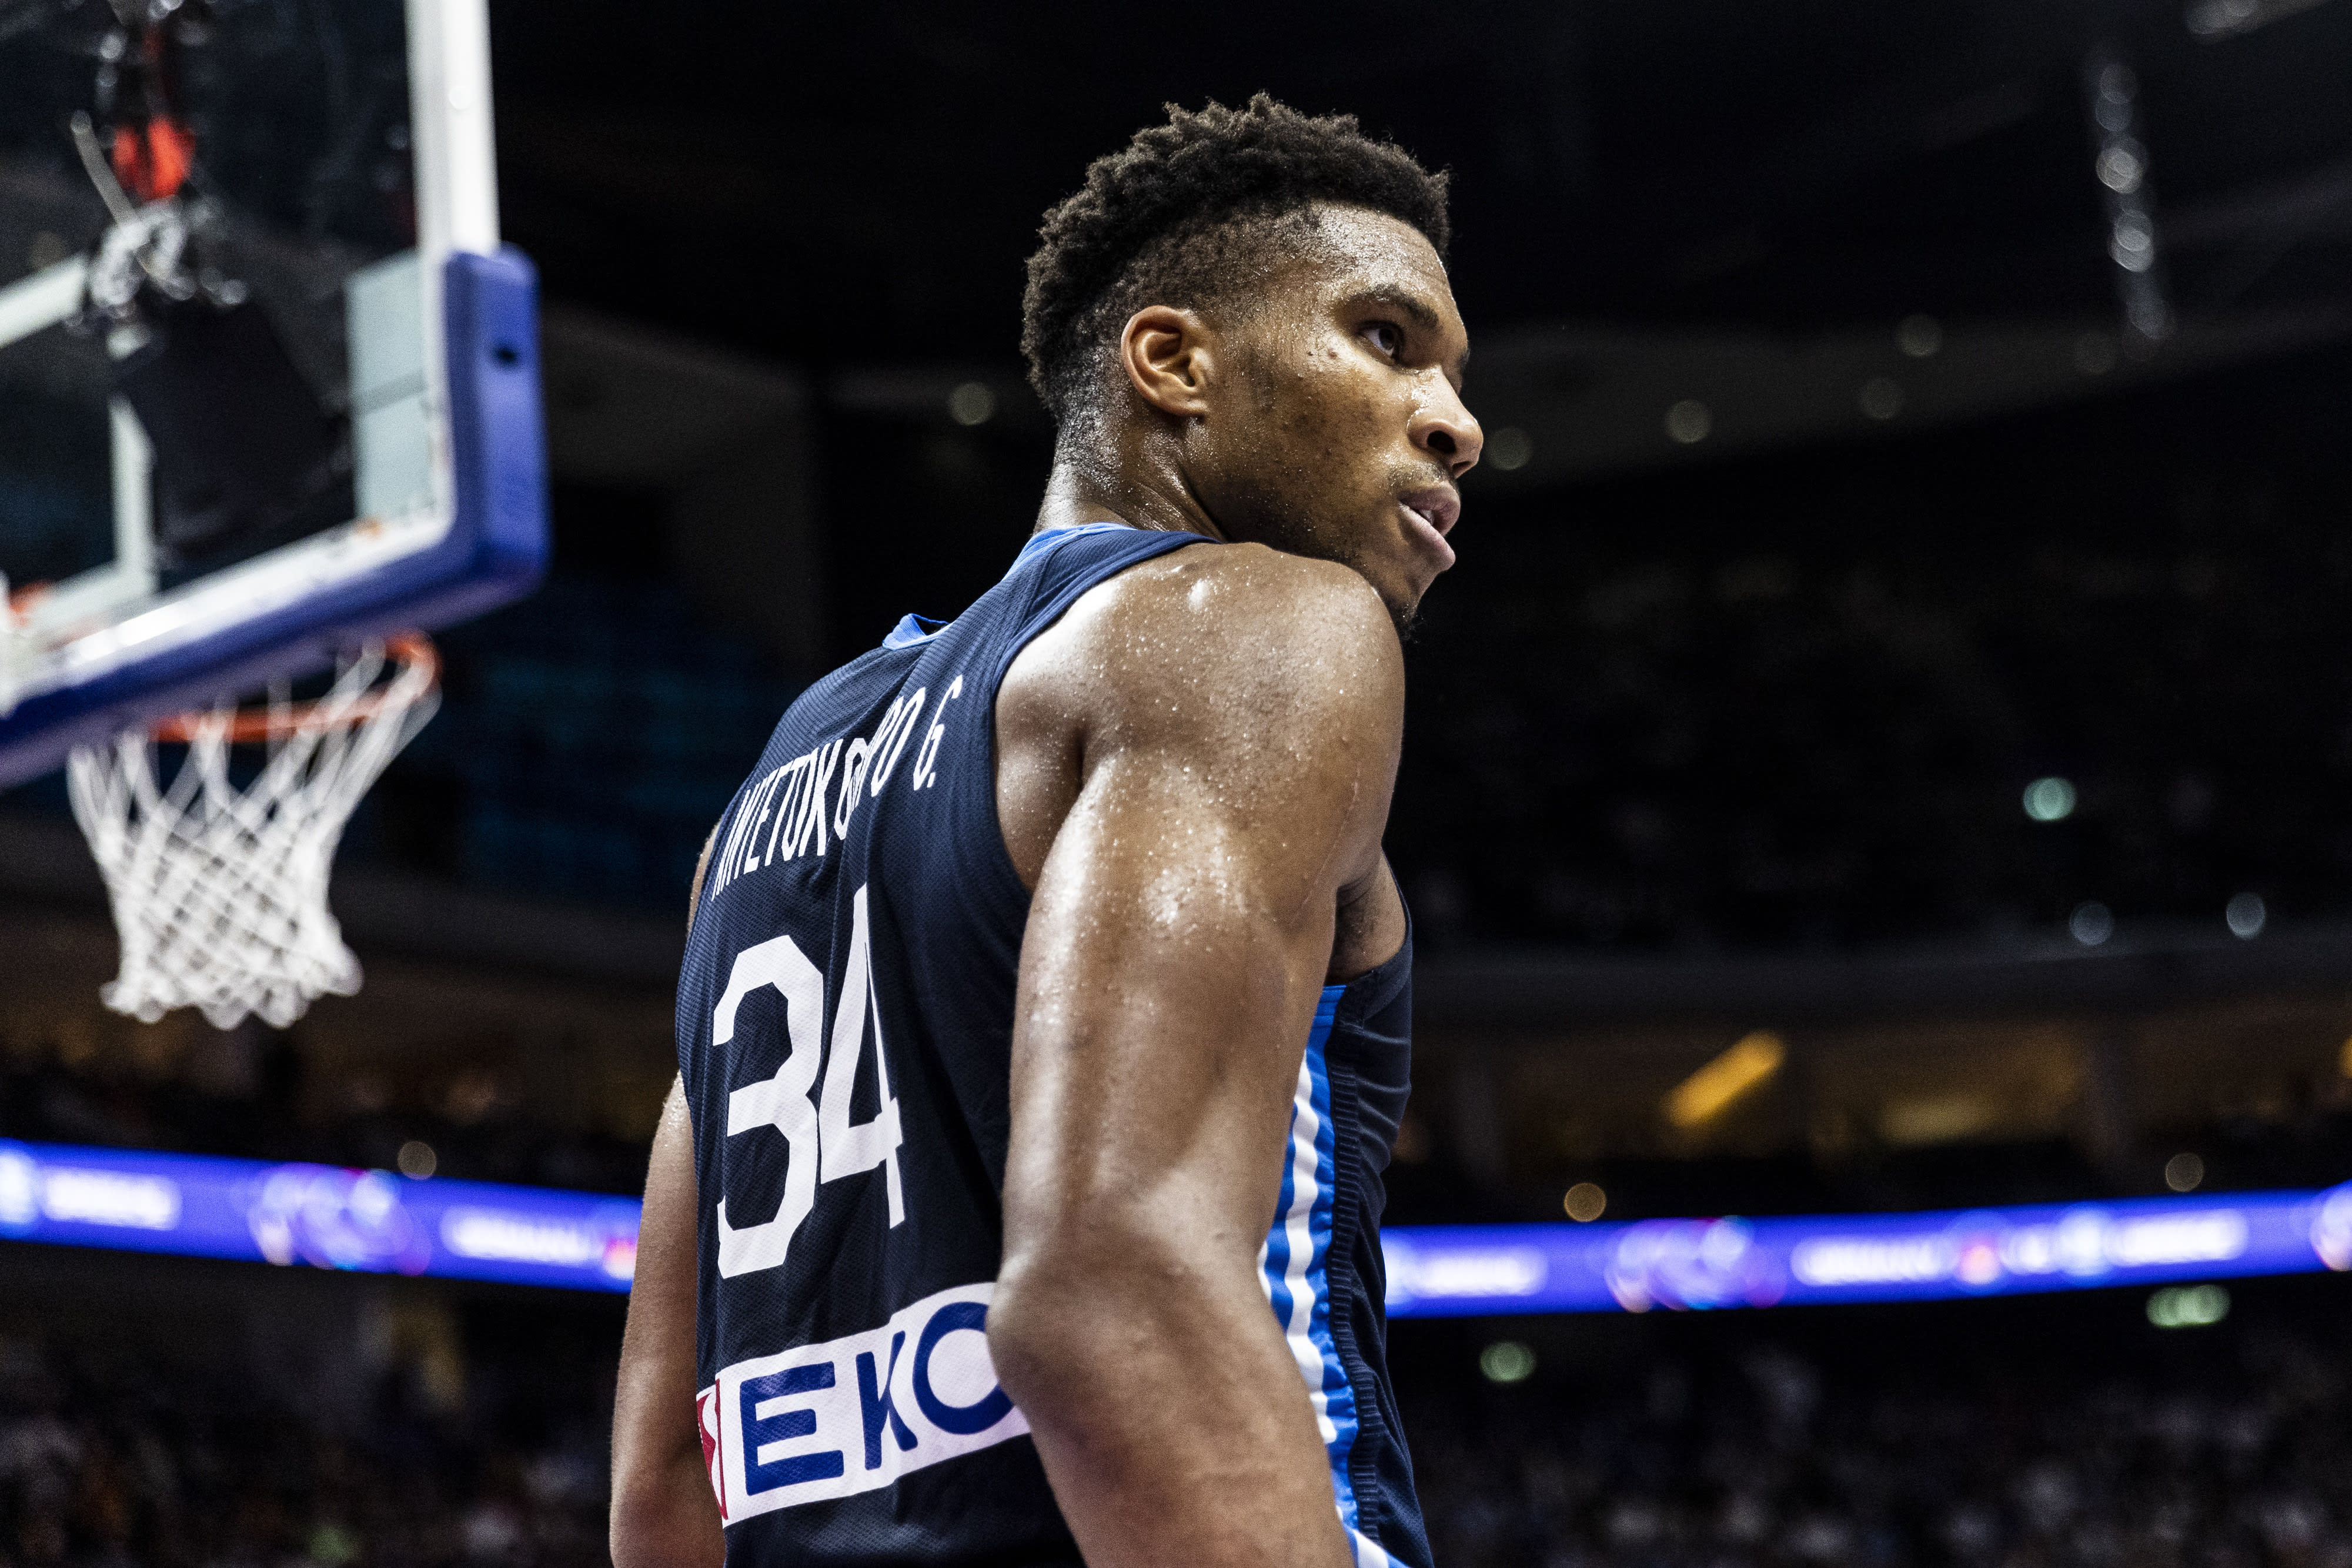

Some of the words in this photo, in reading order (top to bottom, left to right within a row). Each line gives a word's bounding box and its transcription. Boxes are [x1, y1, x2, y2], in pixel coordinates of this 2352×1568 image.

[913, 674, 964, 791] G.
[712, 882, 906, 1279] 34
[740, 1301, 1015, 1497] EKO
